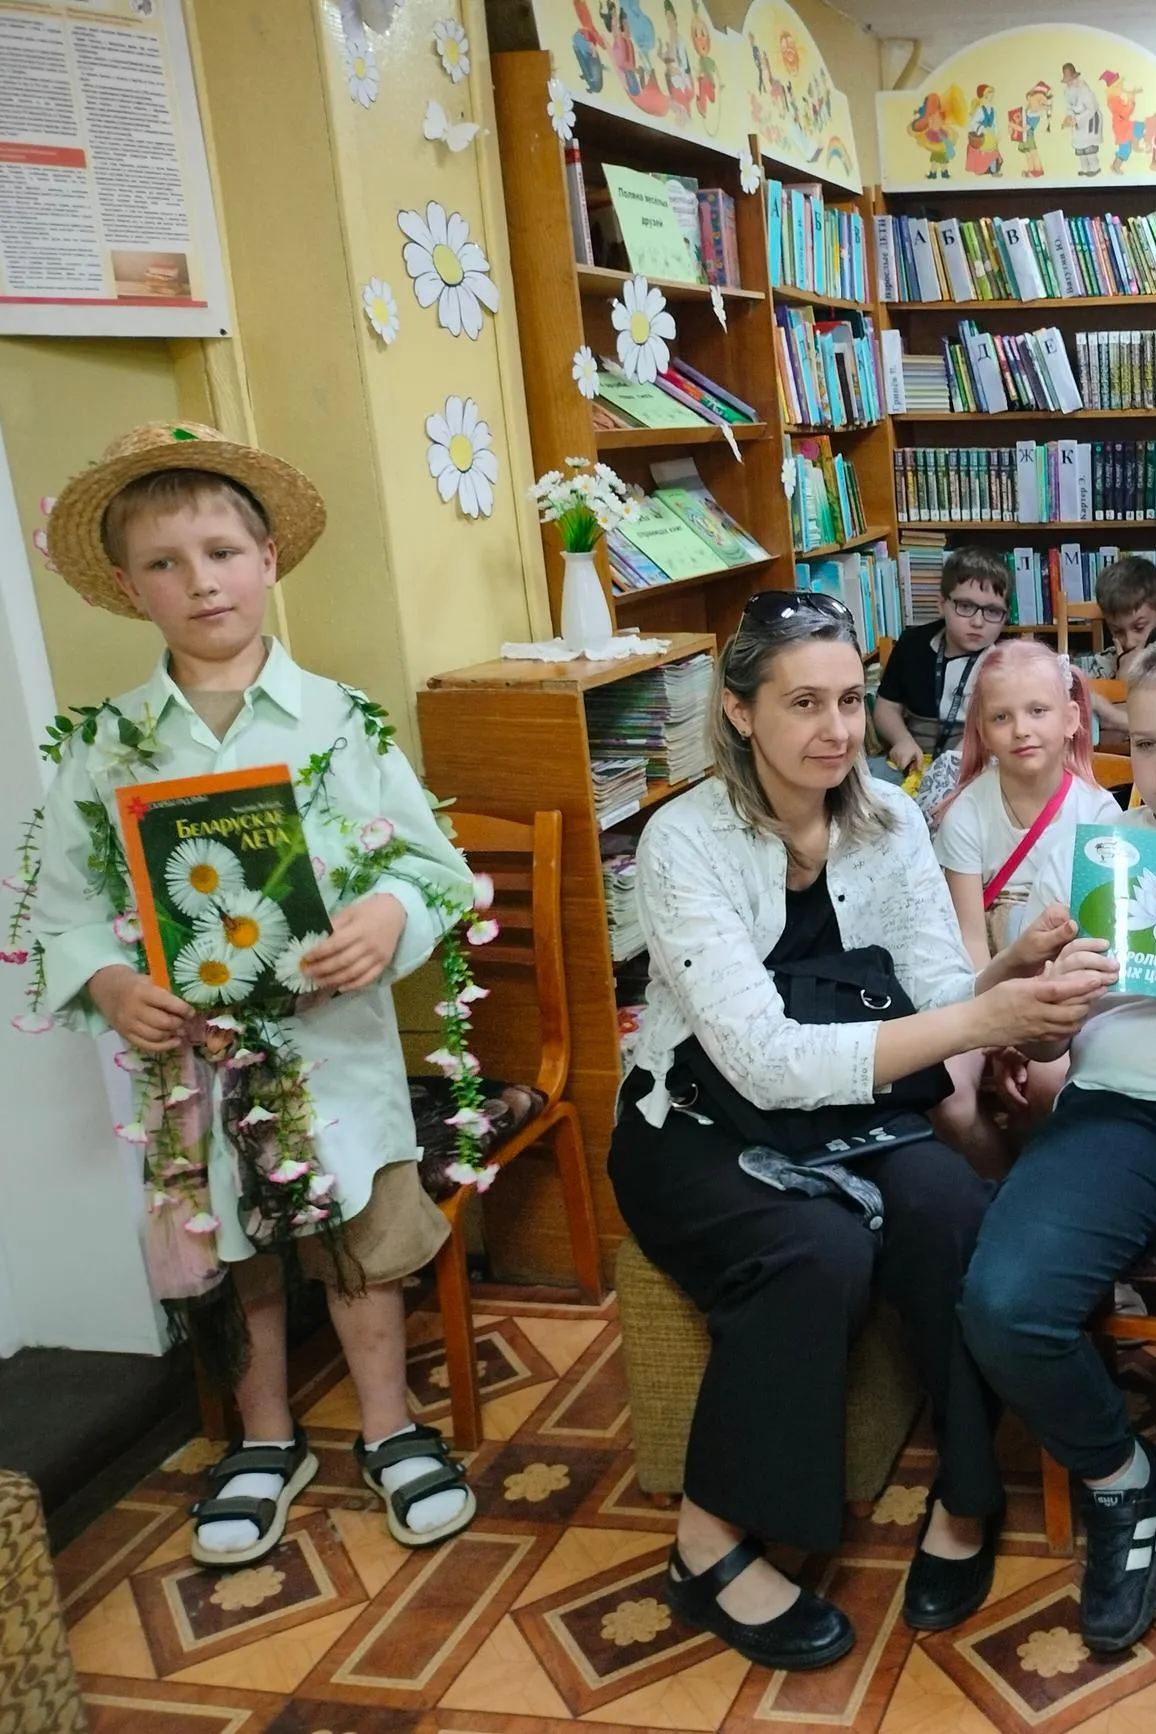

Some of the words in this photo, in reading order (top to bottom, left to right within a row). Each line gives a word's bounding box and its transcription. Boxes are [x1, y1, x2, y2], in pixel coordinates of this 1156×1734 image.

[913, 230, 927, 246] А
[942, 230, 956, 246] Б
[1007, 229, 1020, 245] В
[977, 343, 992, 362] Д
[1046, 338, 1058, 355] Е
[1019, 448, 1034, 463] Ж
[1061, 451, 1074, 465] К
[1016, 558, 1030, 571] Л
[1064, 553, 1079, 566] М
